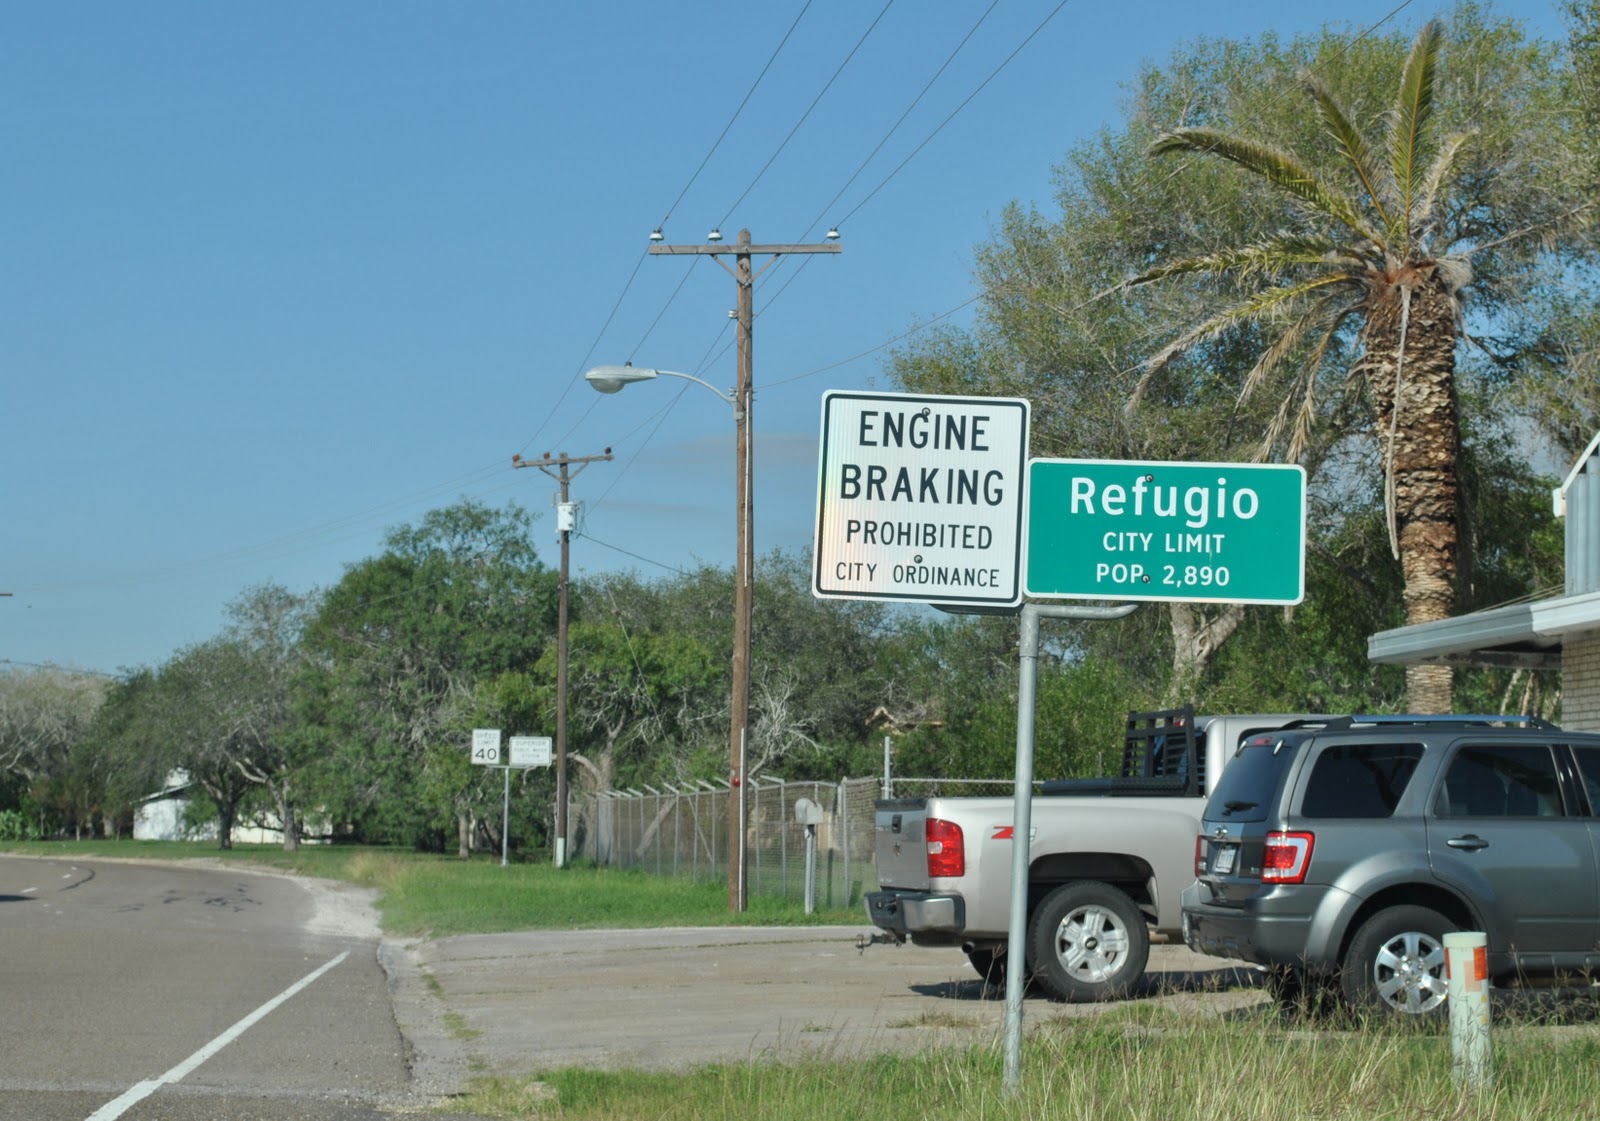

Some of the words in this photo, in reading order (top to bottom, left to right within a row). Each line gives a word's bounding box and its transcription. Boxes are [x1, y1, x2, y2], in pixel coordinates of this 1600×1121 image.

[859, 410, 990, 452] ENGINE
[840, 463, 1004, 507] BRAKING
[1070, 476, 1260, 529] Refugio
[846, 519, 993, 551] PROHIBITED
[1102, 531, 1153, 552] CITY
[1165, 532, 1225, 553] LIMIT
[836, 561, 877, 583] CITY
[893, 564, 1000, 588] ORDINANCE
[1096, 563, 1150, 584] POP
[1162, 564, 1230, 588] 2,890
[475, 747, 497, 760] 40
